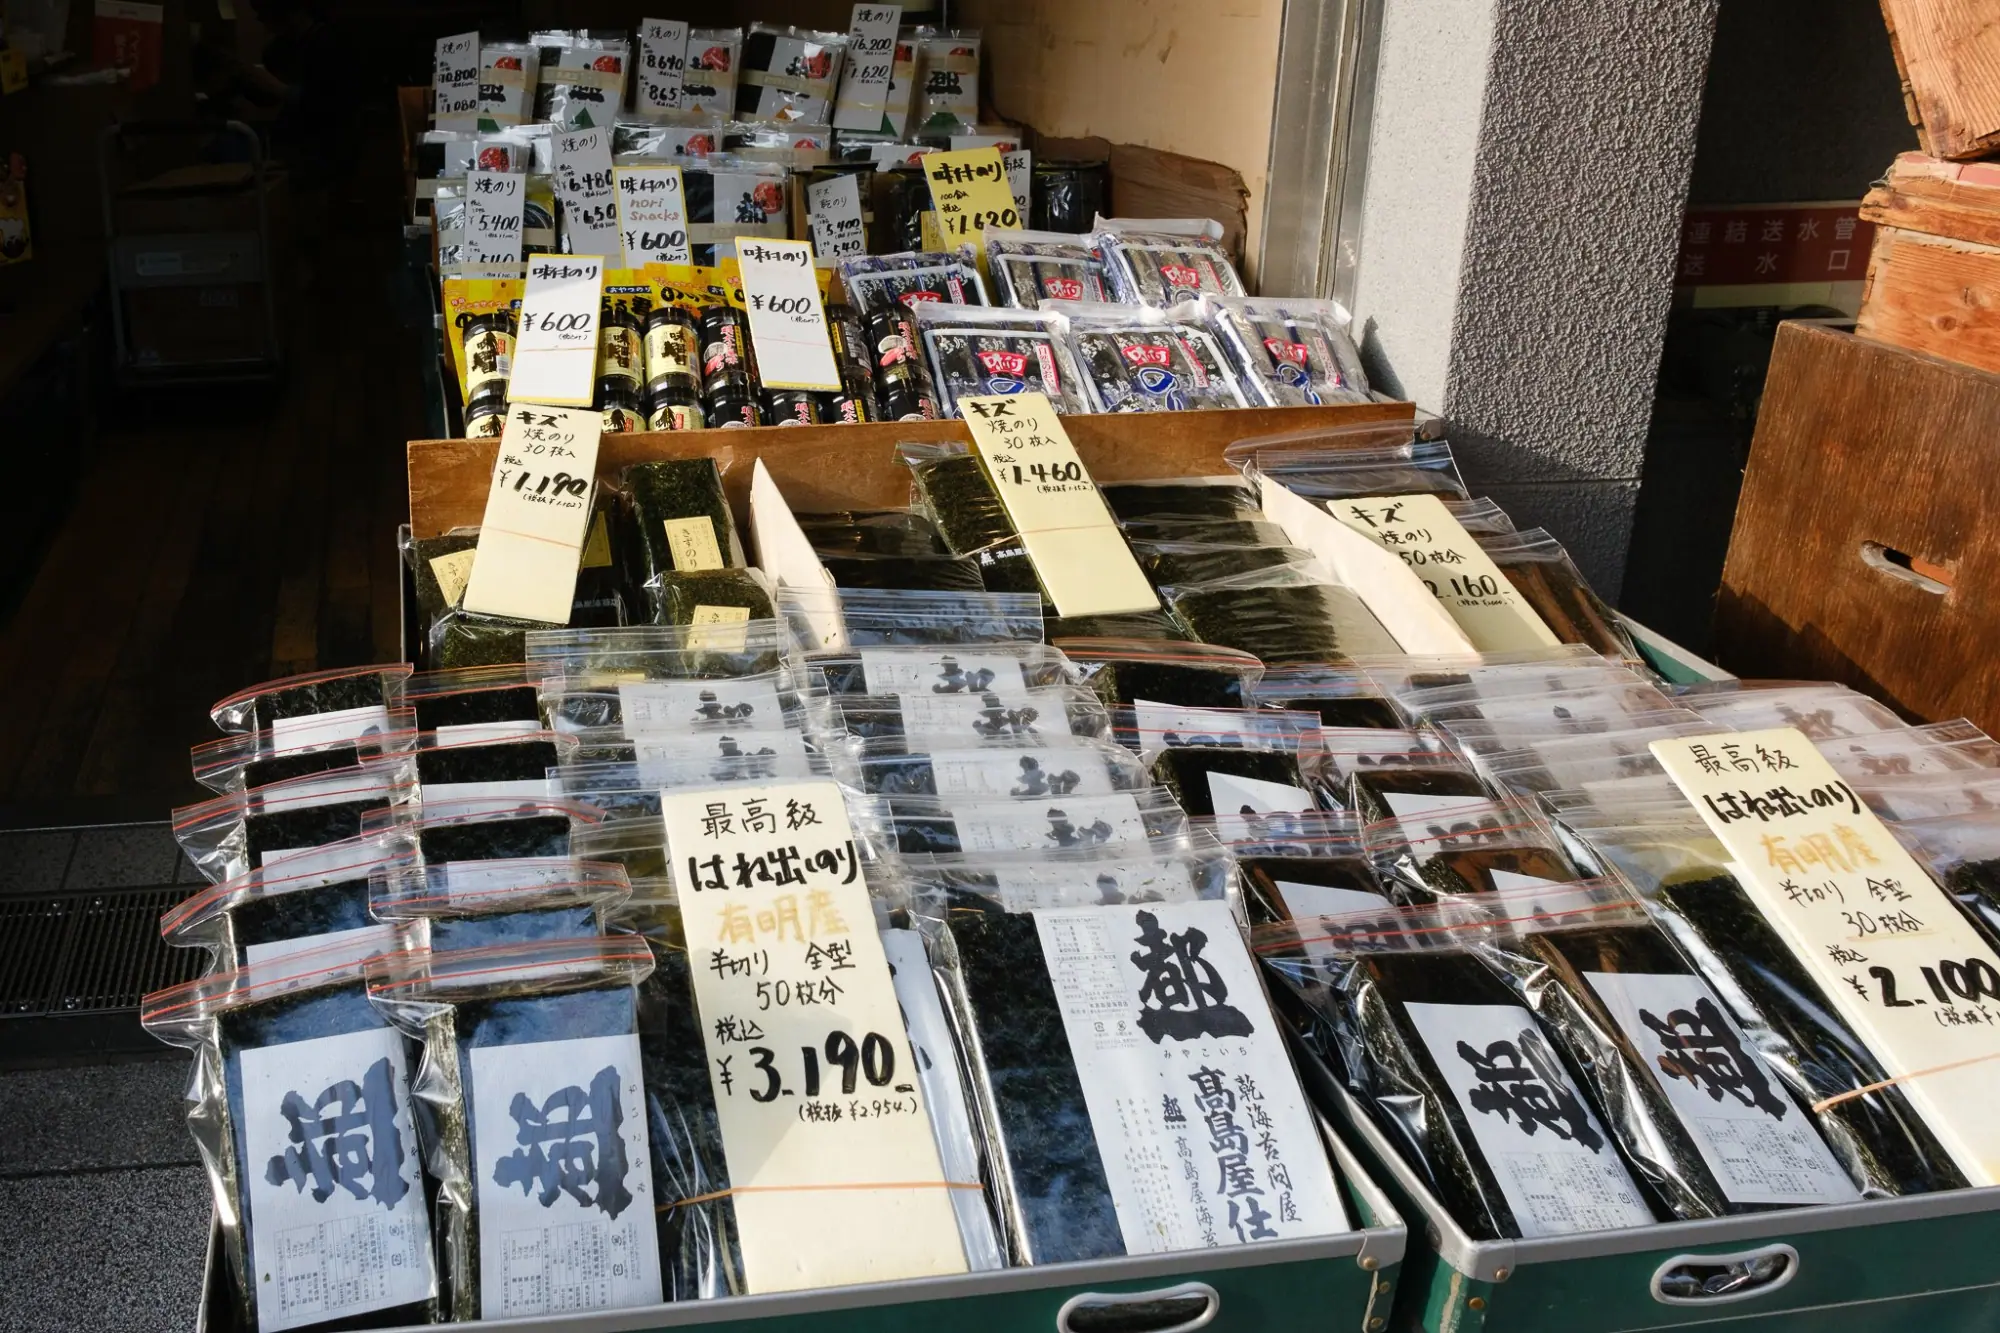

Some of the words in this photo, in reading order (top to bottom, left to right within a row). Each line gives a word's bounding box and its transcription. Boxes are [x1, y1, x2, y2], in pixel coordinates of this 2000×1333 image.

[561, 134, 598, 152] 焼のり
[932, 161, 1002, 184] 味付のり
[475, 178, 516, 196] 焼のり
[620, 177, 678, 195] 味付のり
[630, 198, 664, 209] nori
[629, 209, 679, 221] snacks
[743, 246, 808, 267] 味付のり
[1683, 249, 1850, 276] 送水口
[532, 264, 597, 281] 味付のり
[970, 399, 1017, 418] キズ
[516, 411, 569, 429] キズ
[986, 417, 1038, 434] 焼のり
[522, 428, 575, 445] 焼のり
[503, 454, 523, 466] 税込
[992, 454, 1016, 464] 税込
[1350, 502, 1405, 528] キズ
[1378, 529, 1432, 546] 焼のり
[1688, 743, 1799, 776] 最高級
[1701, 780, 1861, 823] はね出しのり
[700, 797, 823, 840] 最高級
[1759, 822, 1882, 874] 有明産
[687, 840, 859, 892] はね出しのり
[1779, 878, 1845, 908] 半切り
[1865, 877, 1913, 902] 全型
[716, 888, 850, 945] 有明産
[1841, 910, 1925, 938] 30枚分
[709, 949, 769, 980] 半切り
[804, 939, 856, 971] 全型
[1825, 944, 1869, 967] 税込
[756, 975, 845, 1011] 50枚分
[714, 1014, 765, 1046] 税込
[1163, 1046, 1249, 1060] みやこいち
